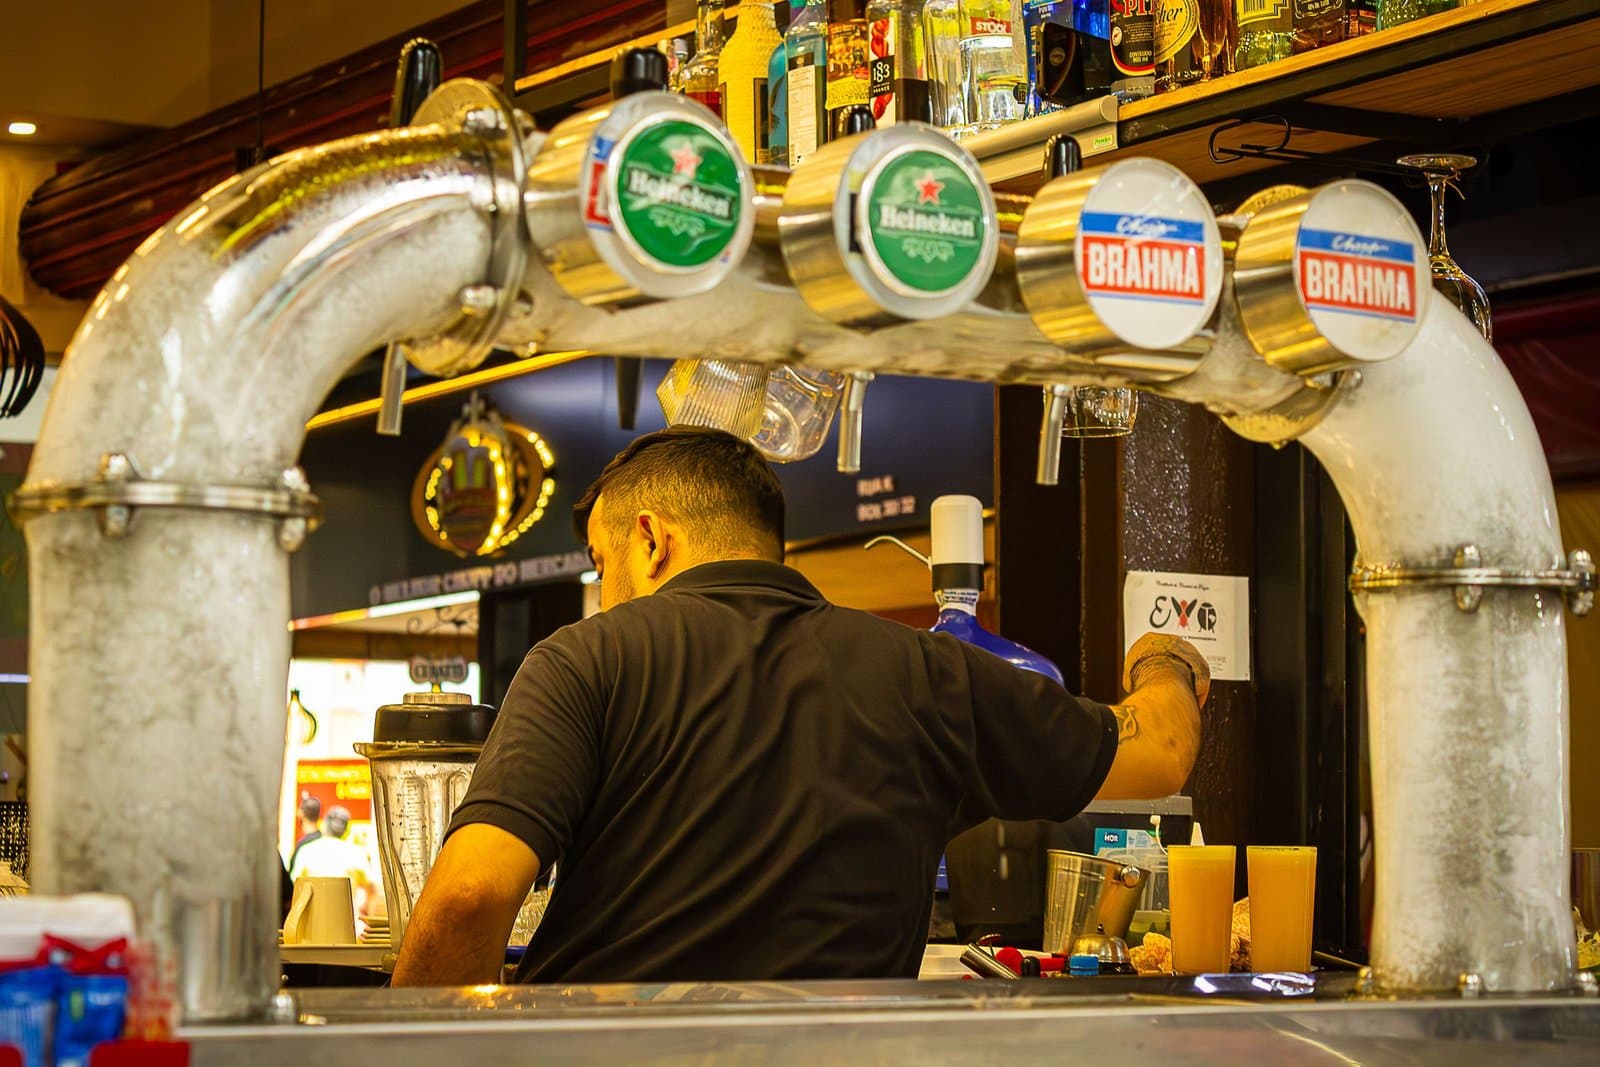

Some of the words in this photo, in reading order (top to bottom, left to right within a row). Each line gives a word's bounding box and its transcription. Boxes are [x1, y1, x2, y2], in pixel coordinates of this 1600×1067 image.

[873, 62, 890, 82] 183
[629, 168, 730, 219] Heineken
[879, 204, 976, 238] Heineken
[1088, 241, 1200, 294] BRAHMA
[1305, 257, 1412, 312] BRAHMA
